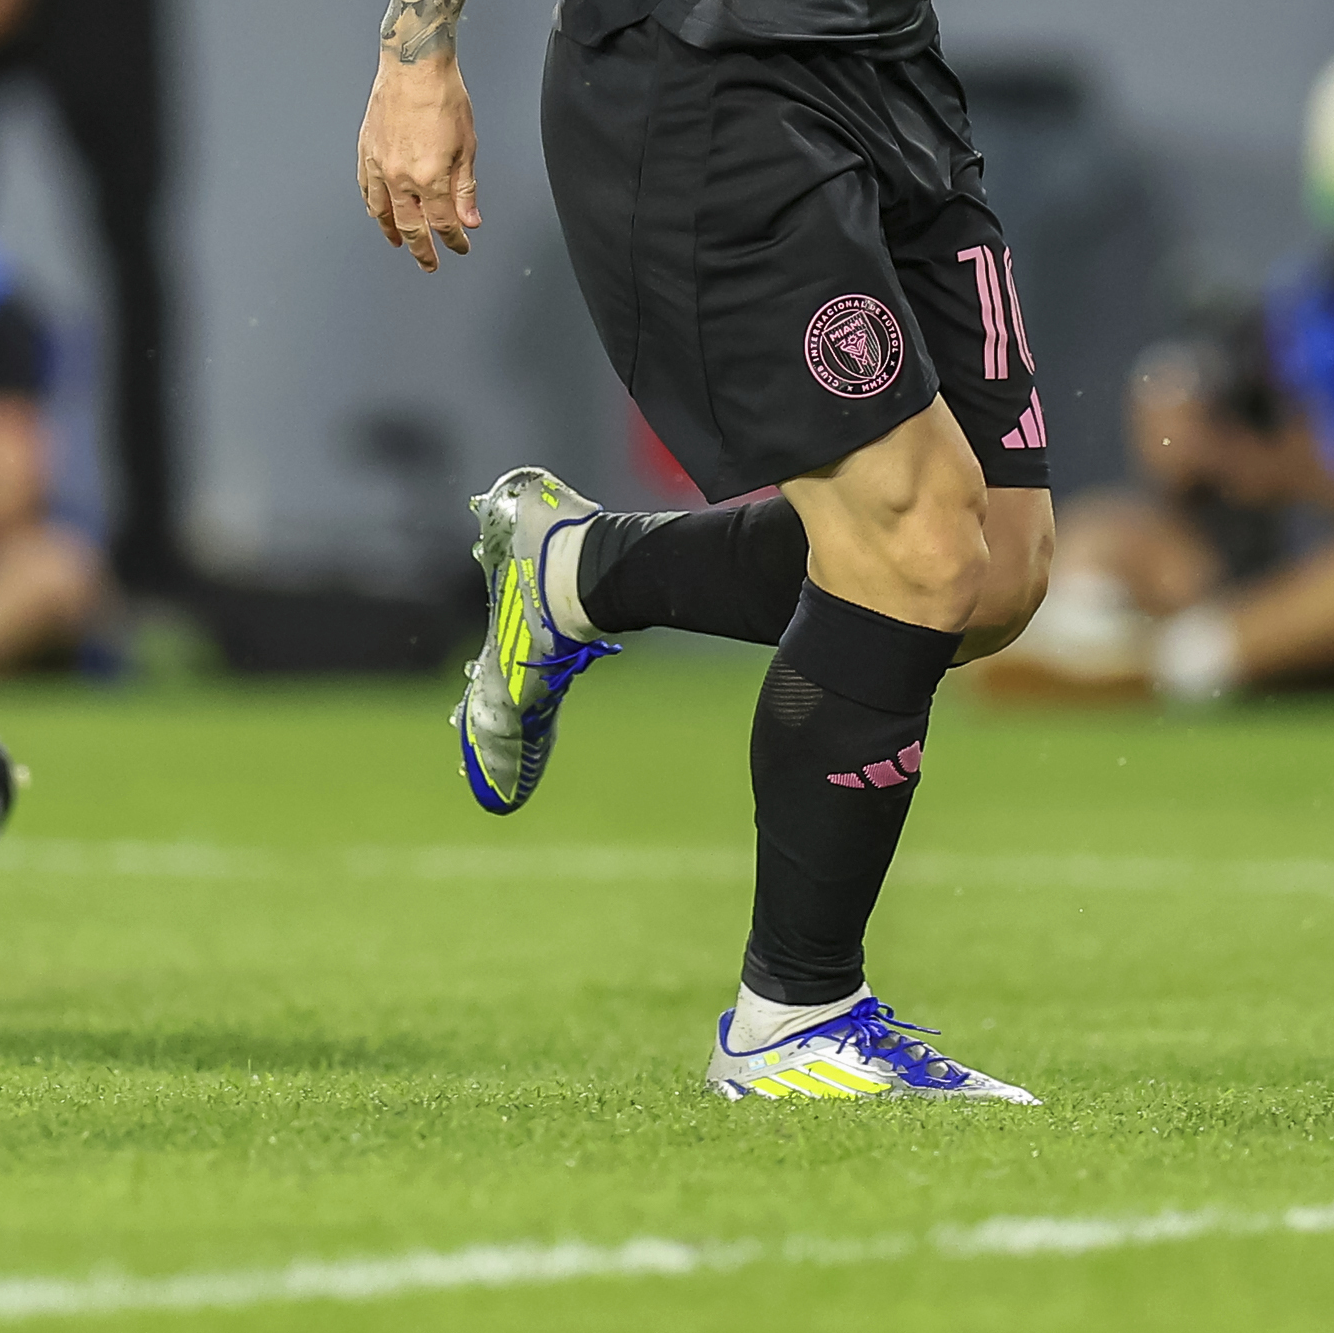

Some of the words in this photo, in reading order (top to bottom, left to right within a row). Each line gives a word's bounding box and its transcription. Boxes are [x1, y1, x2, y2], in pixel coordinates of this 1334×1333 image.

[869, 303, 882, 315] DE
[810, 299, 867, 362] INTERNACIONAL
[829, 317, 864, 342] MIAMI
[817, 365, 839, 387] CLUB
